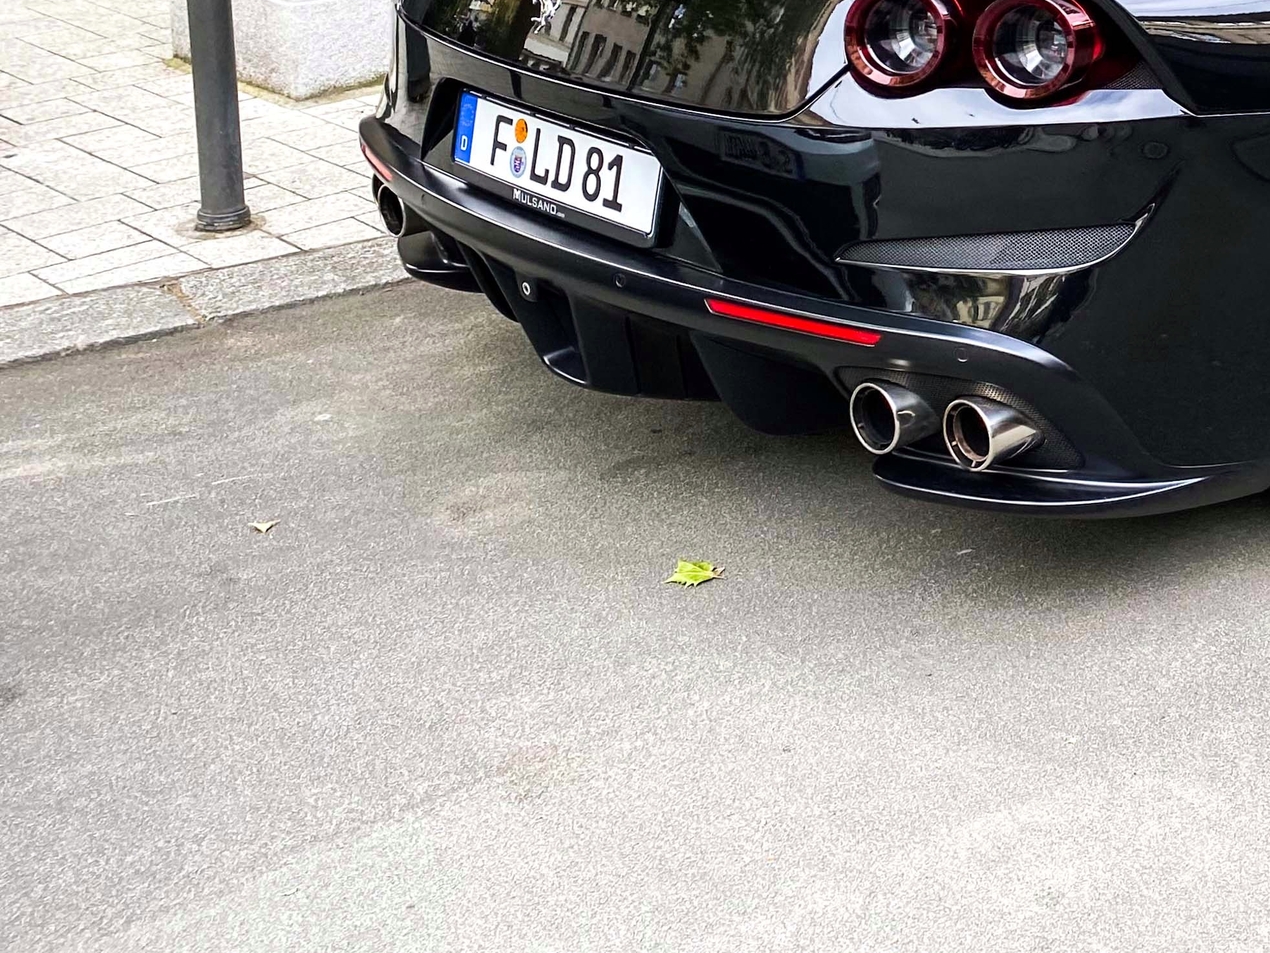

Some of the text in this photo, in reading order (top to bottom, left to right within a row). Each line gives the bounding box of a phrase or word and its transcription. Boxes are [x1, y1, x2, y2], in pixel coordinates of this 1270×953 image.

[490, 114, 624, 213] F LD 81
